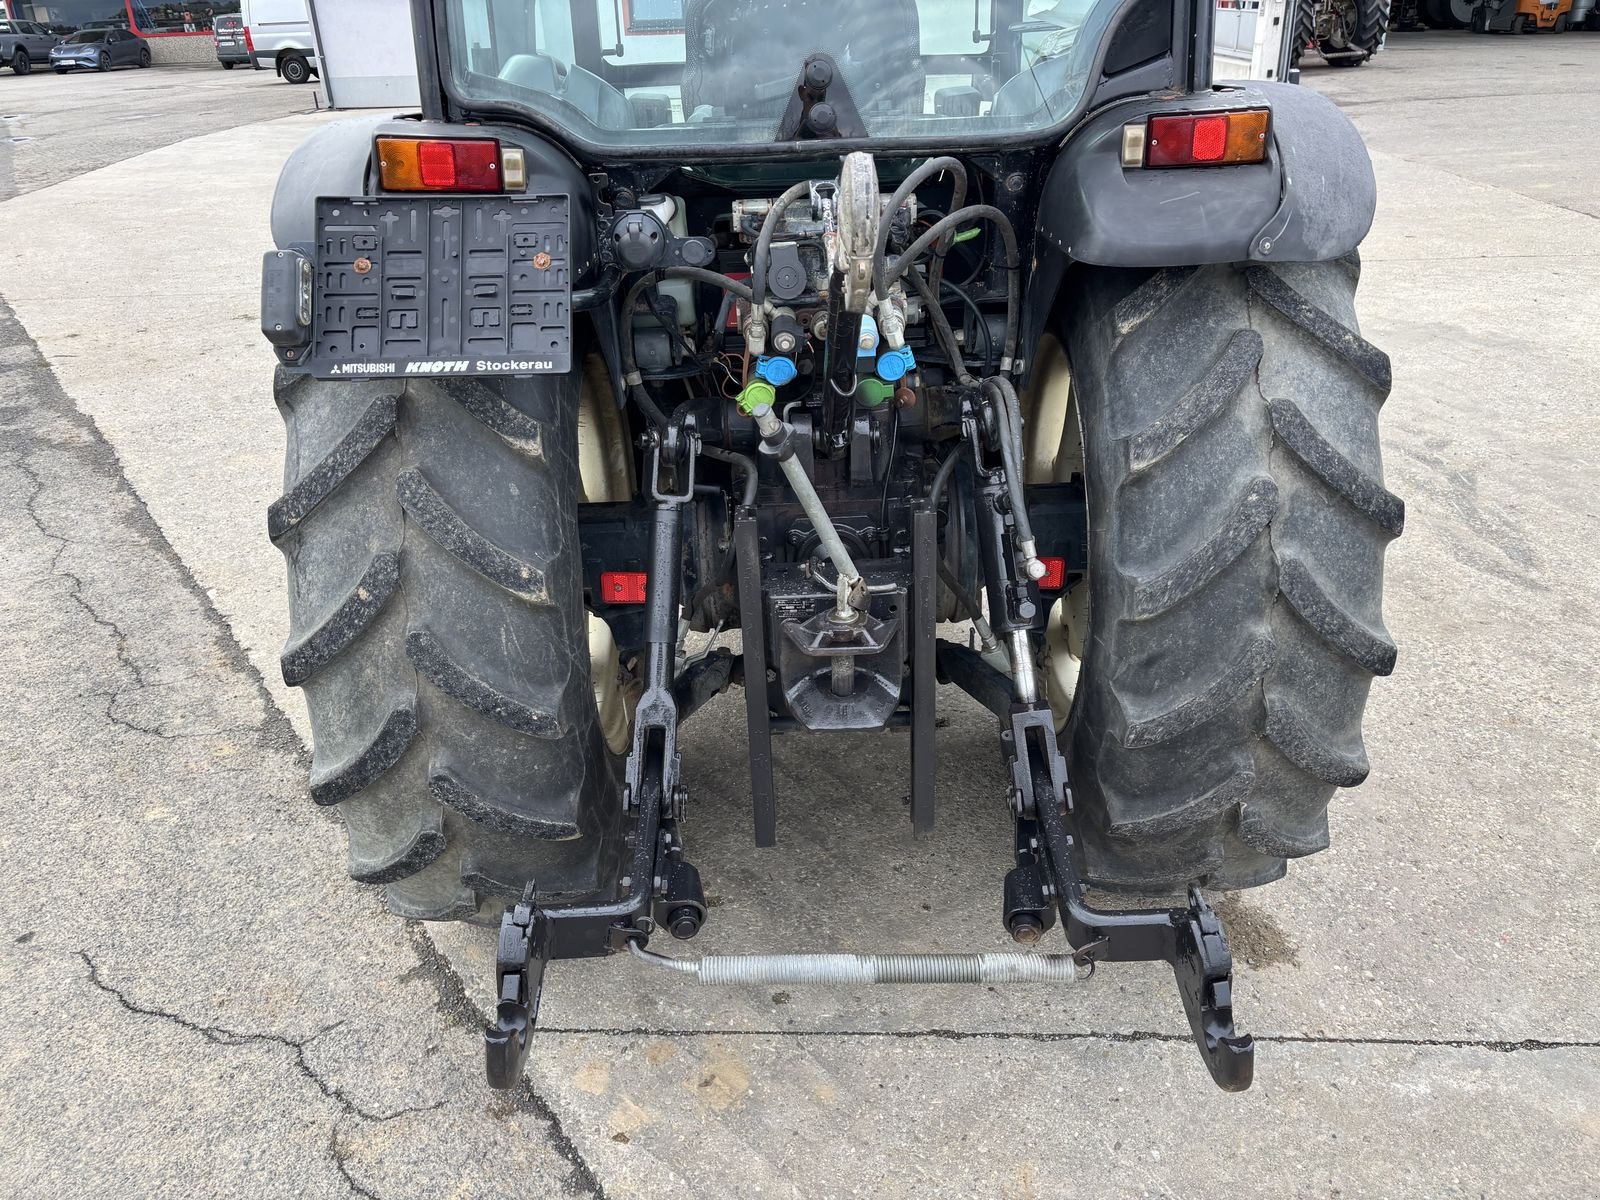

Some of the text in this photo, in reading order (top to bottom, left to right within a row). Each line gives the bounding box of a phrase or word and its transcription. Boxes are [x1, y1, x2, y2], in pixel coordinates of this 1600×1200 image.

[342, 360, 553, 373] MITSUBISHI KNOTH Stockerau
